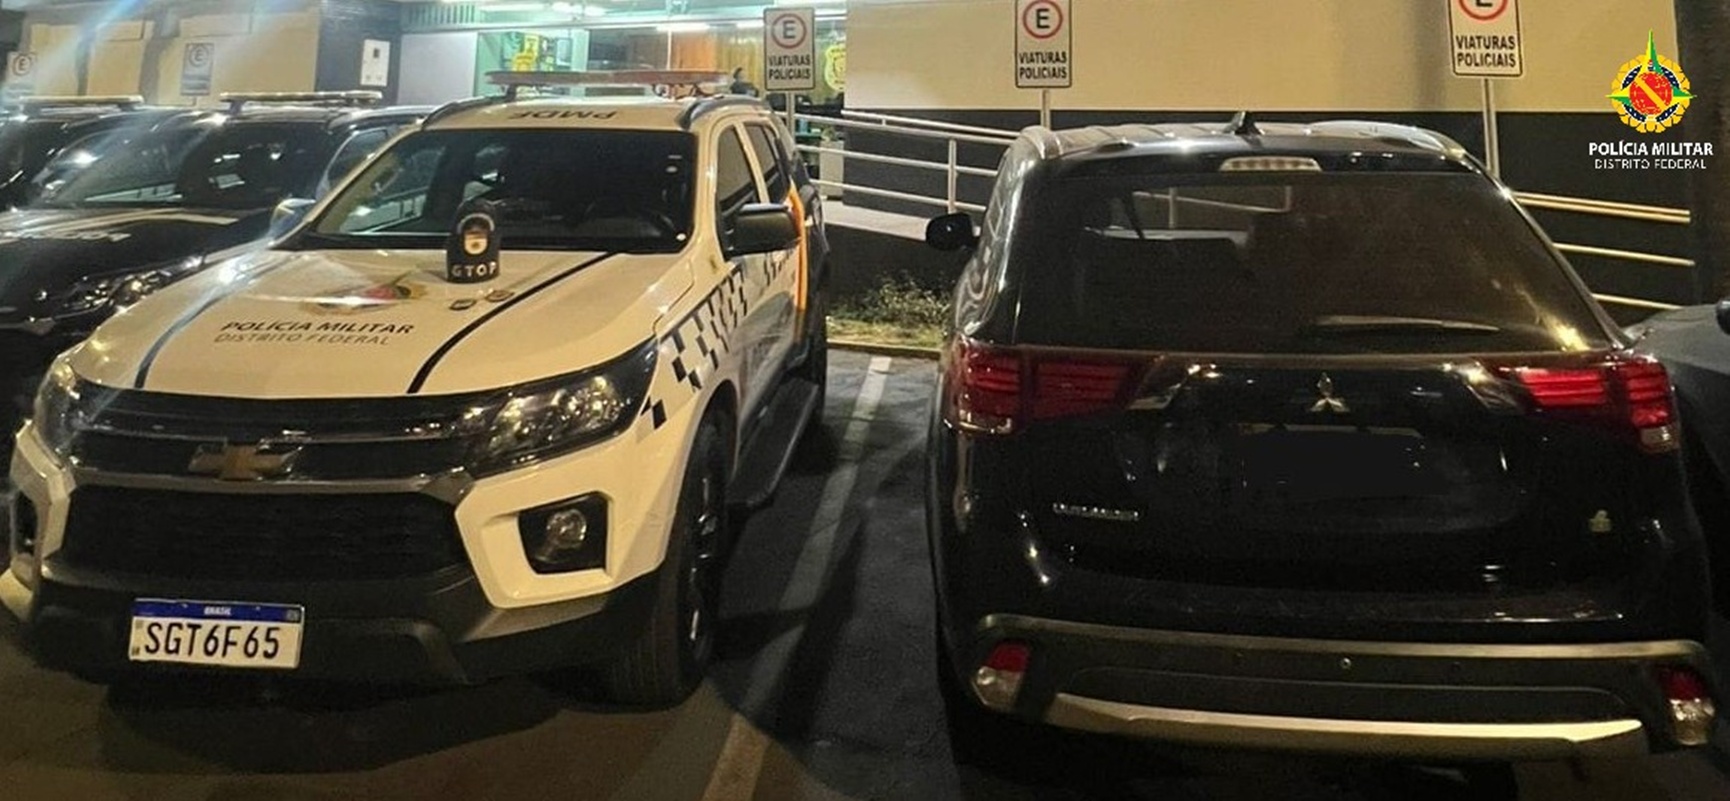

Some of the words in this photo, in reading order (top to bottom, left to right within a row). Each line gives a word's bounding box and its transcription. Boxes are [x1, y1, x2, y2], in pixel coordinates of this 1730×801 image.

[1036, 8, 1050, 29] E
[783, 20, 796, 39] E
[1455, 35, 1516, 50] VIATURAS
[769, 54, 811, 66] VIATURAS
[1019, 51, 1067, 64] VIATURAS
[1457, 52, 1517, 68] POLICIAIS
[768, 68, 811, 80] POLICIAIS
[1019, 66, 1067, 79] POLICIAIS
[452, 262, 497, 277] GTOP
[316, 321, 414, 334] MILITAR
[214, 333, 302, 343] DISTRITO
[303, 334, 390, 345] FEDERAL
[145, 622, 280, 659] SGT6F65
